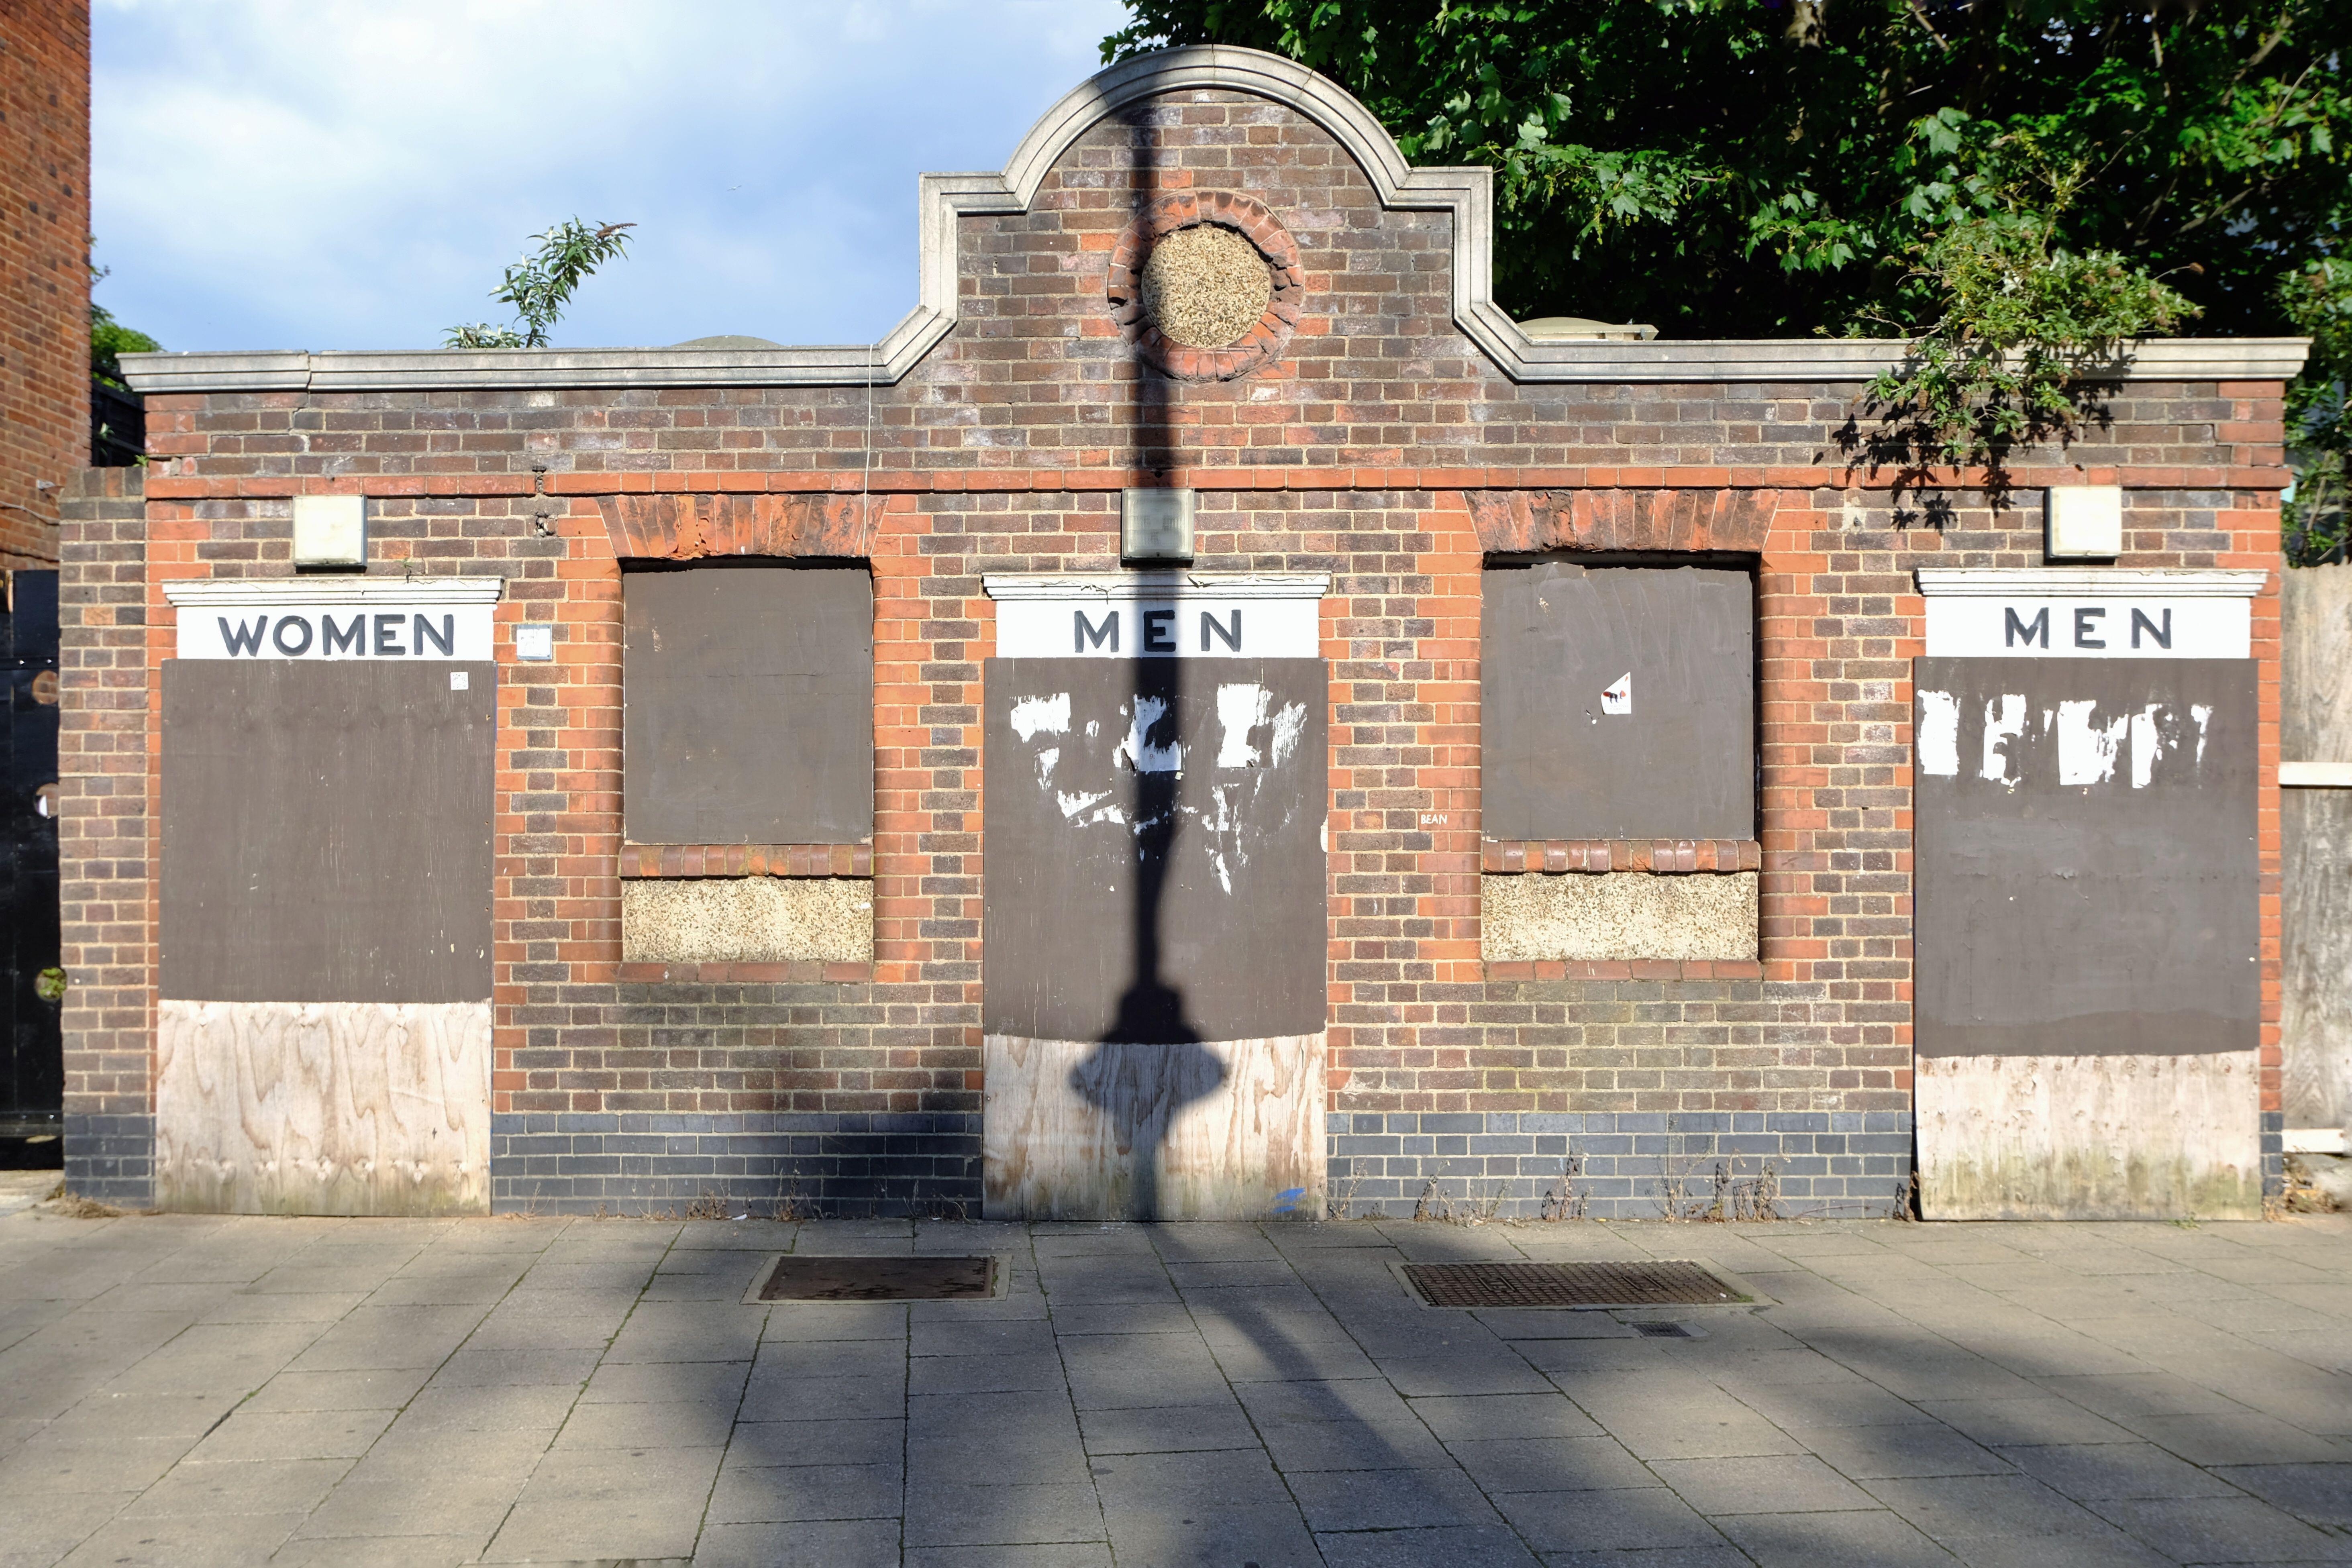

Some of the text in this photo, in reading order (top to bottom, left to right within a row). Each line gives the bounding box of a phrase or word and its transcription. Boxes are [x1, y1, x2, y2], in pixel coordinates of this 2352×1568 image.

[217, 614, 454, 657] WOMEN
[1074, 609, 1242, 653] MEN
[2005, 607, 2172, 649] MEN
[1421, 814, 1448, 824] BEAN
